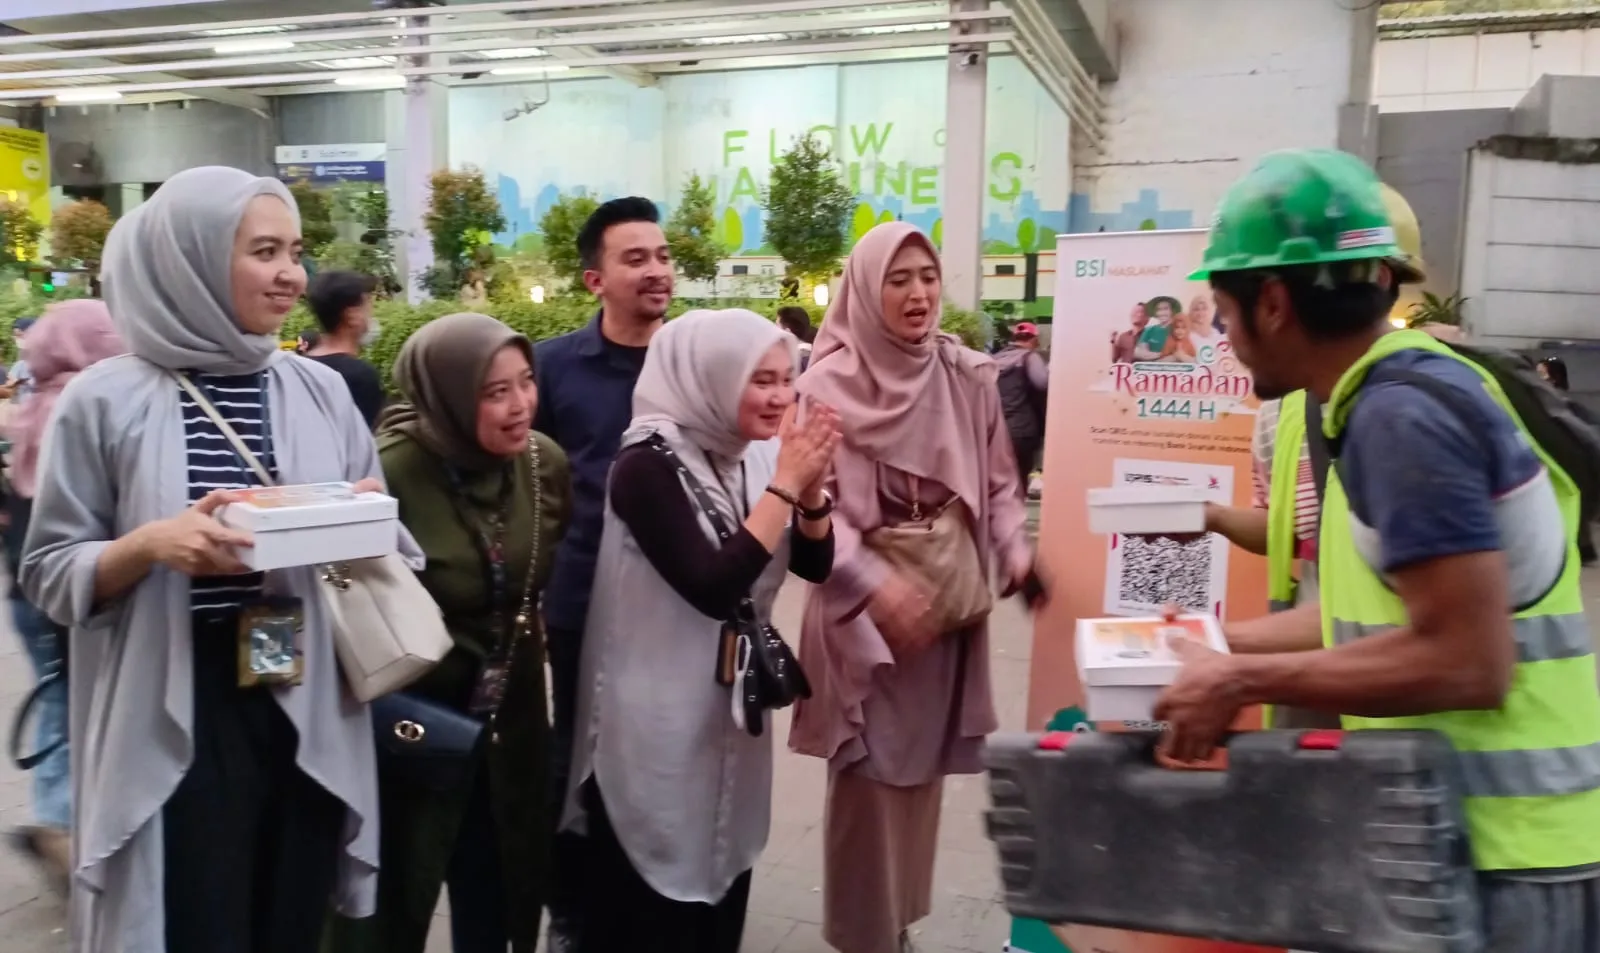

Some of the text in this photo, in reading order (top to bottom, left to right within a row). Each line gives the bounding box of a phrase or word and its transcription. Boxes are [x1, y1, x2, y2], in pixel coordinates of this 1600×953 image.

[1075, 259, 1105, 278] BSI
[1109, 363, 1250, 397] Ramadan
[1136, 398, 1216, 420] 1444 H
